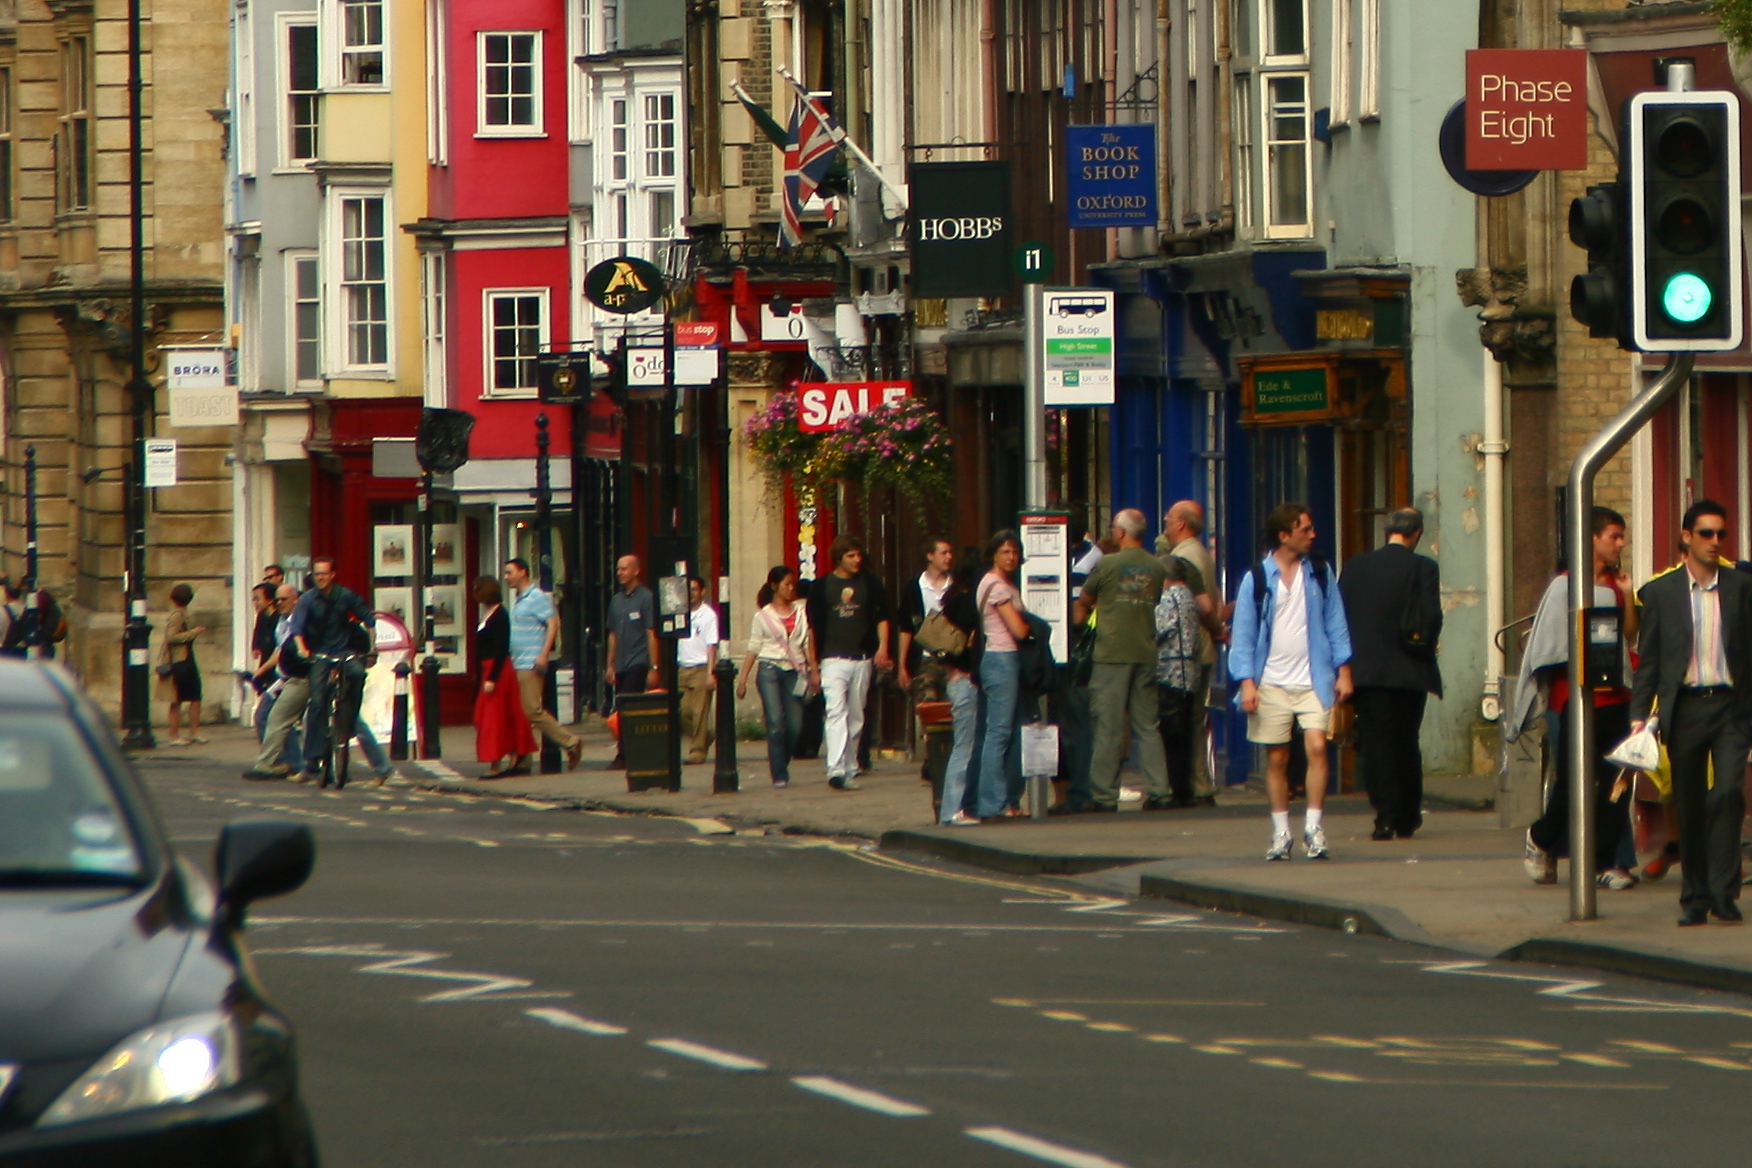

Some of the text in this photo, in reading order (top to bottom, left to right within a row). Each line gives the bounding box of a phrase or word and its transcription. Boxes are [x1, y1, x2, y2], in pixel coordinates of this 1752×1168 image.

[1481, 75, 1572, 102] Phase
[1481, 111, 1555, 145] Eight
[1082, 146, 1140, 162] BOOK
[1083, 165, 1140, 180] SHOP
[1077, 194, 1147, 211] OXFORD
[1025, 249, 1041, 270] i1
[693, 325, 715, 336] stop
[1057, 324, 1100, 337] Bus Stop
[174, 365, 220, 376] BRORA
[1258, 380, 1291, 391] Ede &
[175, 394, 233, 418] TOAST
[1258, 392, 1323, 405] Ravenscroft
